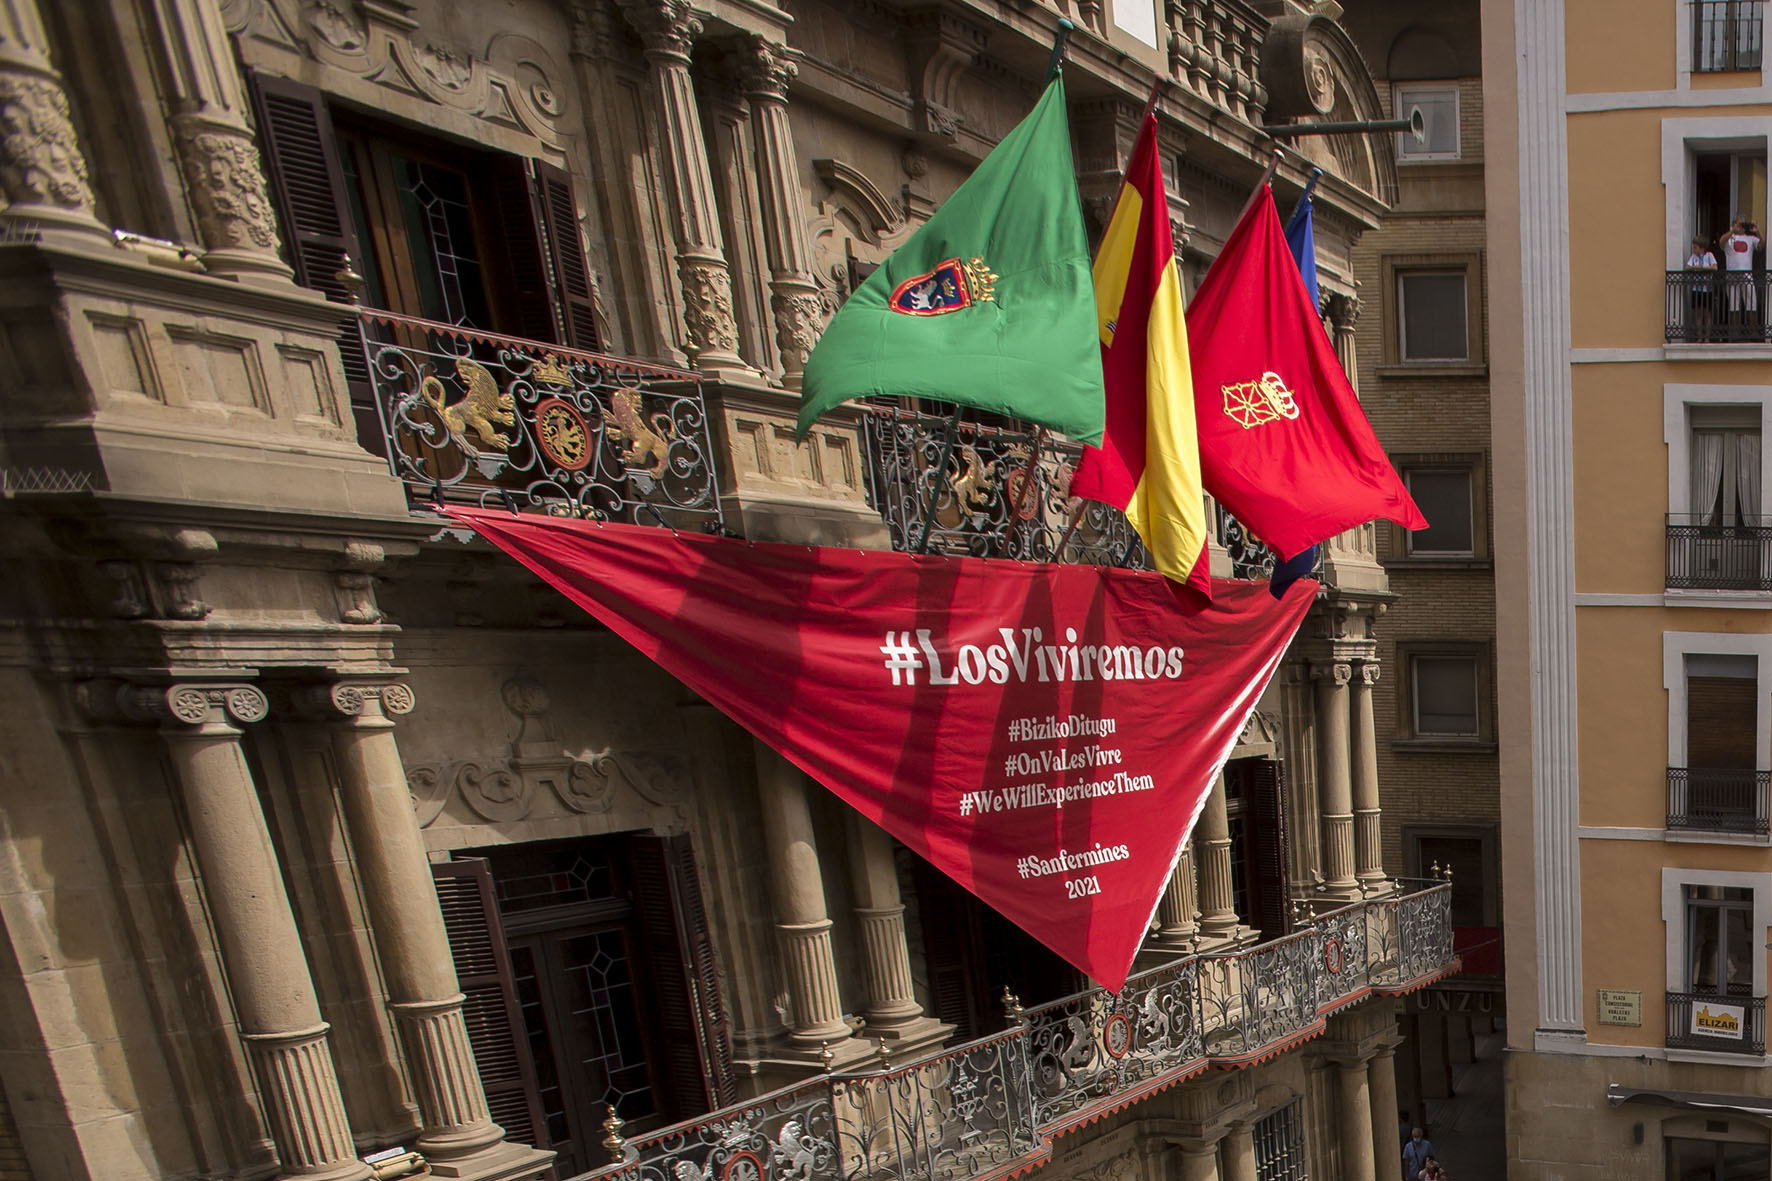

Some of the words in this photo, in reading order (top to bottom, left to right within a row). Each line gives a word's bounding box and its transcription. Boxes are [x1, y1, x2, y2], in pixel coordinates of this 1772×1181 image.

[879, 626, 1184, 685] #LosViviremos
[1008, 714, 1116, 741] #BizikoDitugu
[1005, 745, 1122, 777] #OnVaLesVivre
[959, 771, 1155, 816] #WeWillExperienceThem
[1017, 843, 1130, 879] #Sanfermines
[1065, 876, 1101, 899] 2021
[1699, 1018, 1738, 1030] ELIZARI
